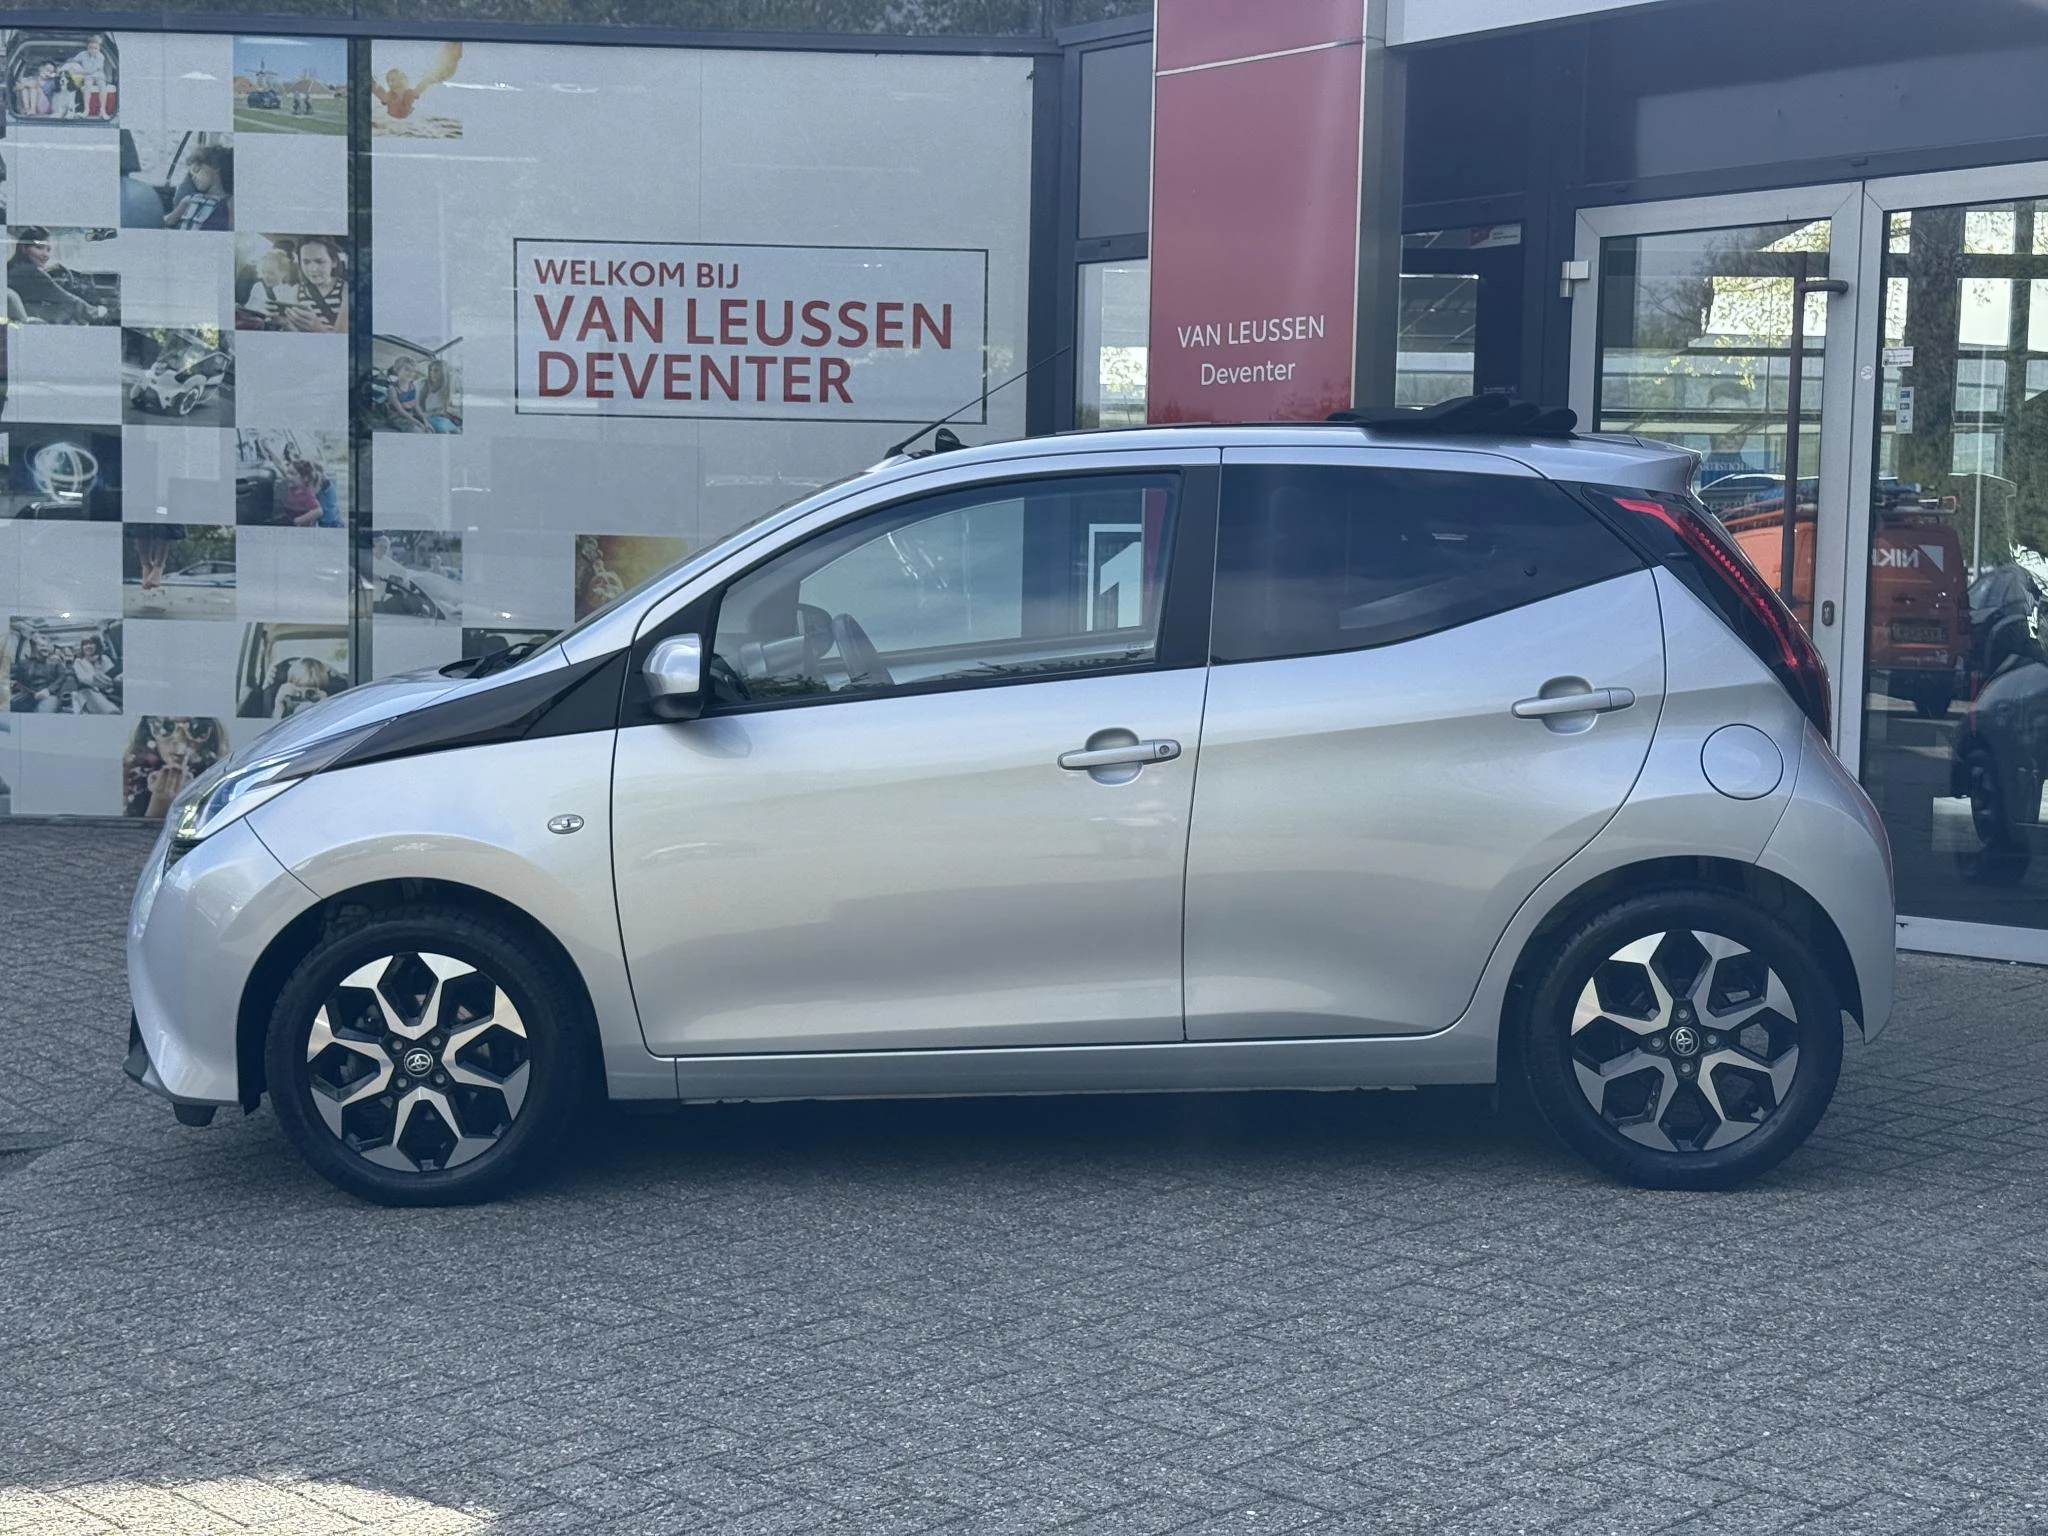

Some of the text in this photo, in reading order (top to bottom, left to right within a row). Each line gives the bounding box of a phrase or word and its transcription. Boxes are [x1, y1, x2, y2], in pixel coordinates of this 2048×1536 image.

[534, 258, 740, 289] WELKOM BIJ
[533, 295, 952, 350] VAN LEUSSEN
[1177, 315, 1325, 348] VAN LEUSSEN
[538, 350, 854, 404] DEVENTER
[1200, 360, 1296, 386] Deventer
